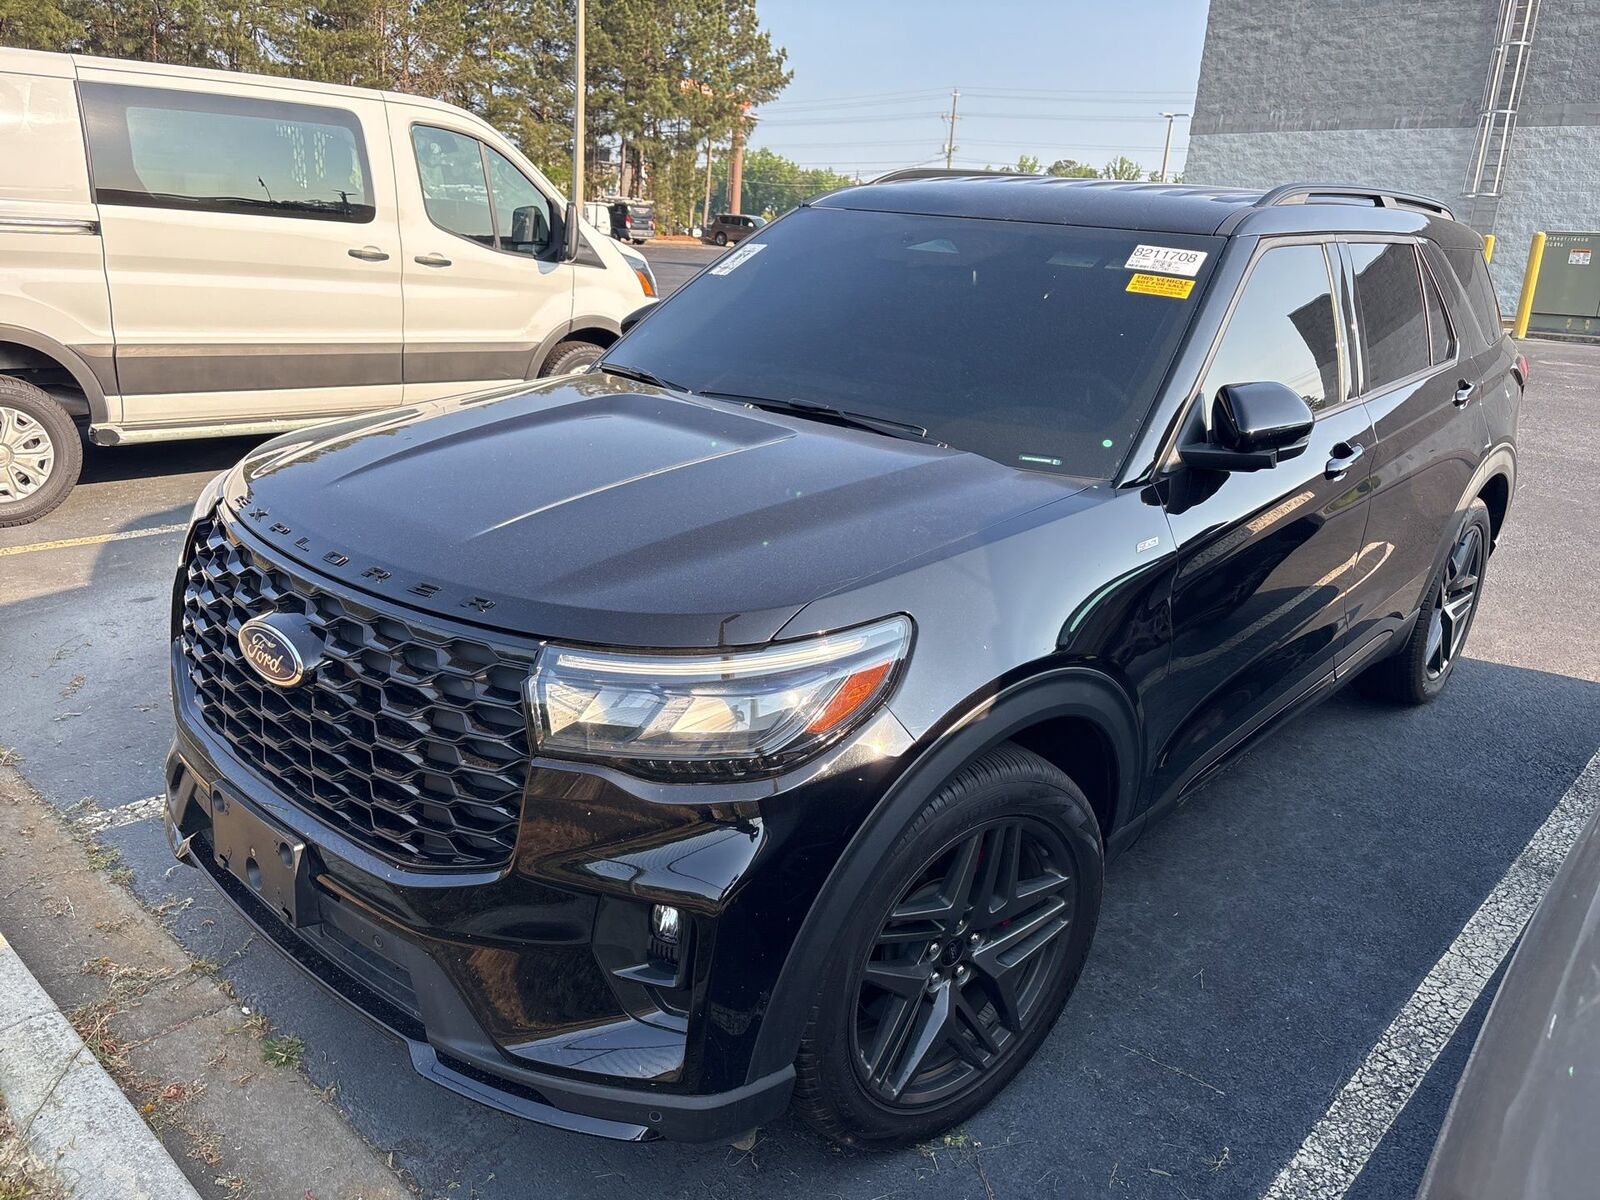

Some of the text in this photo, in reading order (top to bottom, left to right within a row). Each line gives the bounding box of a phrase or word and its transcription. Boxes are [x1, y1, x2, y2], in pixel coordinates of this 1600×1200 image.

[1133, 247, 1198, 263] 8211708
[1156, 277, 1190, 286] VEHICLE
[233, 494, 498, 614] EXPLORER
[247, 633, 284, 673] Ford
